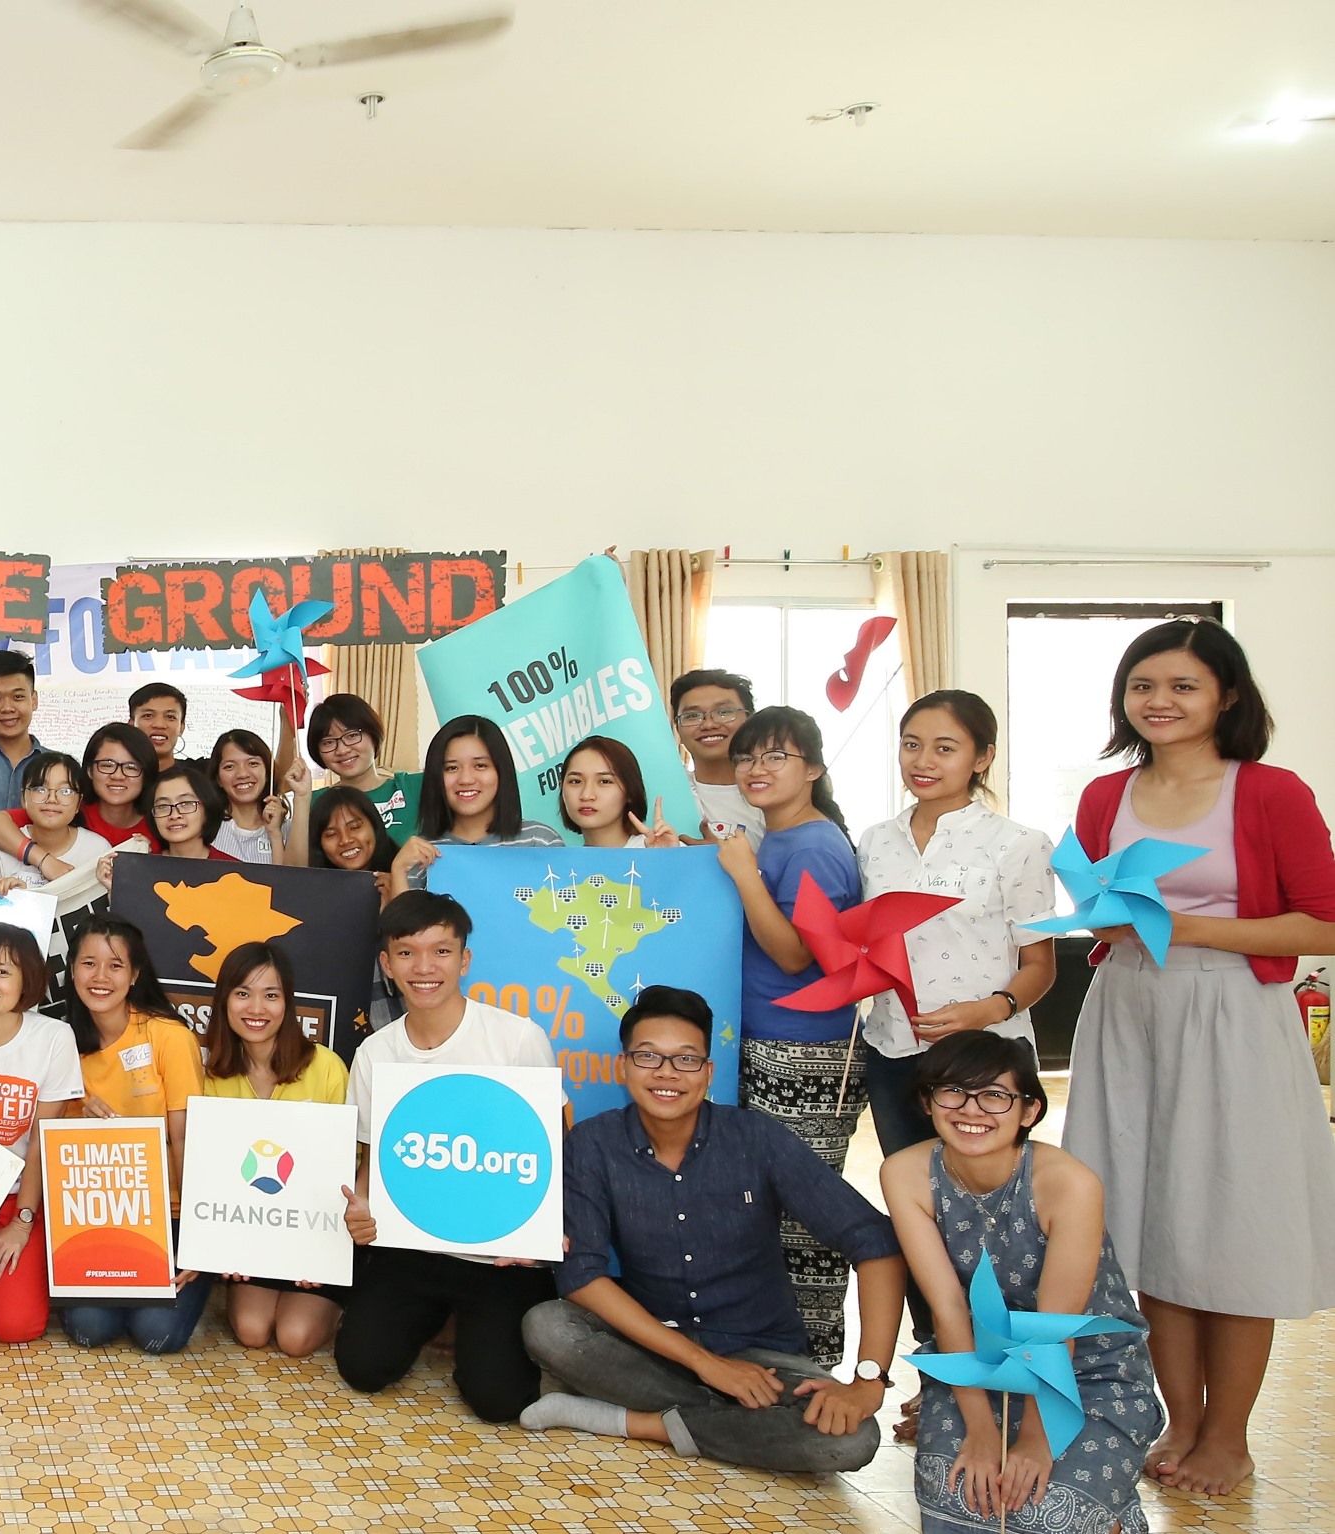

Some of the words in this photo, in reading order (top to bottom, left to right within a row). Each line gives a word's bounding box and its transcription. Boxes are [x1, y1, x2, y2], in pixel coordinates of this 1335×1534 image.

[108, 559, 497, 645] GROUND
[486, 645, 578, 713] 100%
[59, 1142, 148, 1167] CLIMATE
[400, 1132, 538, 1185] 350.org
[61, 1166, 149, 1190] JUSTICE
[61, 1189, 152, 1227] NOW!
[85, 1269, 138, 1279] #PEOPLESCLIMATE
